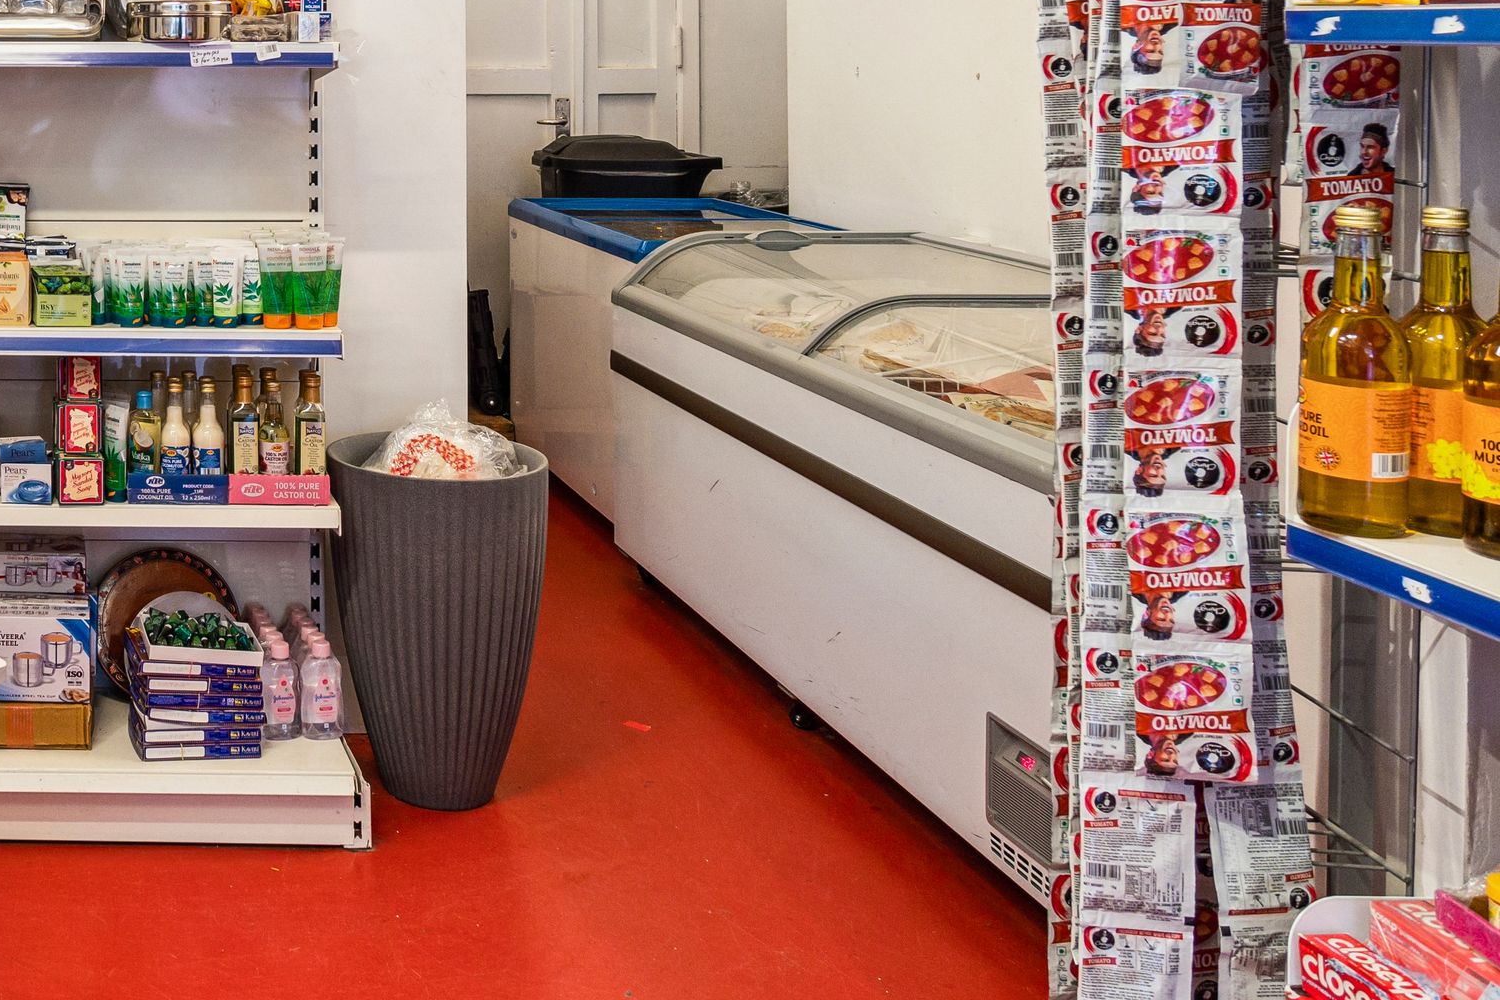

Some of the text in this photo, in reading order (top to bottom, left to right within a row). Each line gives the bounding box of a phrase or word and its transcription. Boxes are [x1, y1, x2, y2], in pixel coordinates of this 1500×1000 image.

[1195, 6, 1253, 22] TOMATO
[1138, 143, 1219, 162] TOMATO
[1320, 178, 1383, 196] TOMATO
[1140, 285, 1218, 304] TOMATO
[1141, 427, 1217, 444] TOMATO
[1309, 425, 1329, 439] OIL
[11, 449, 35, 458] Pears
[1474, 450, 1500, 466] MUS
[4, 466, 27, 474] Pears
[275, 482, 320, 490] 100% PURE
[273, 491, 320, 499] CASTOR OIL
[1146, 570, 1228, 589] TOMATO
[66, 670, 83, 678] ISO
[1152, 714, 1232, 731] TOMATO
